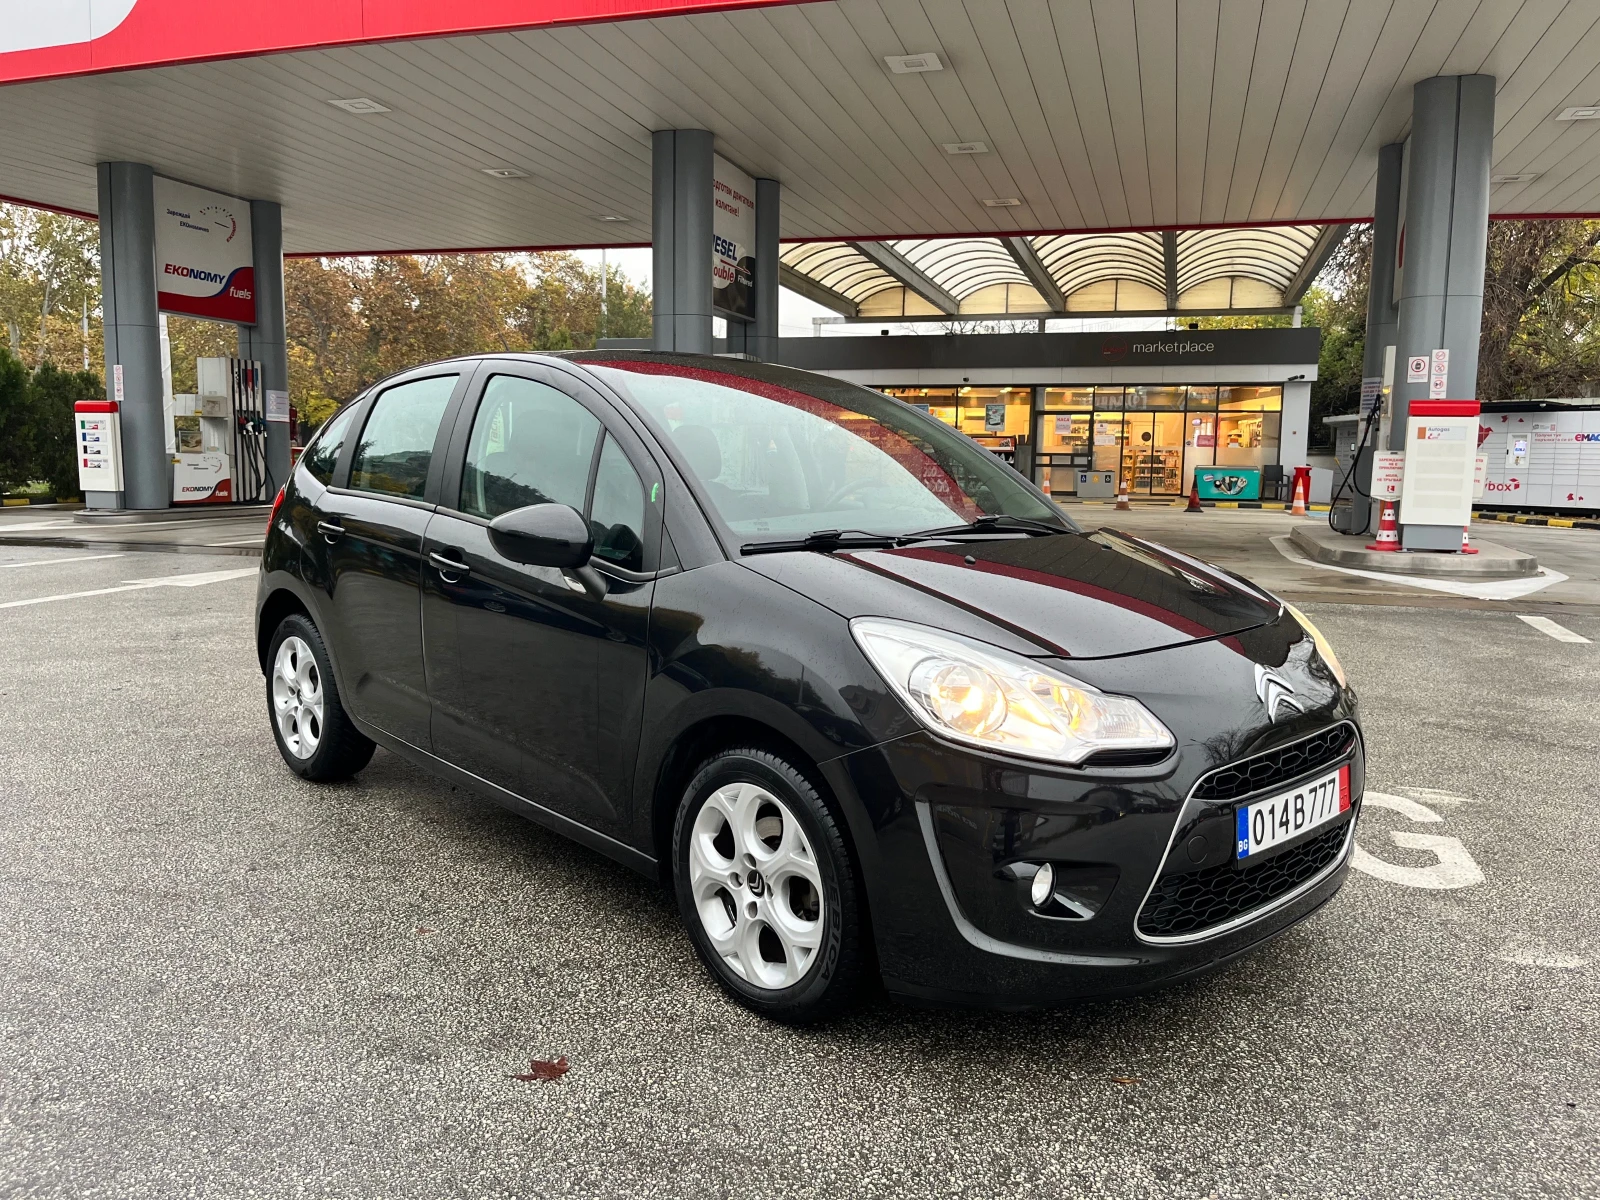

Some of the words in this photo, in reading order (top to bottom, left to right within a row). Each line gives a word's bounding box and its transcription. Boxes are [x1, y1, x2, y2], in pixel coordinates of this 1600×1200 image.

[164, 263, 226, 284] EKONOMY
[229, 286, 252, 300] fuels
[1133, 340, 1215, 355] marketplace
[1575, 433, 1600, 442] eMA
[1253, 777, 1336, 846] 014B777
[1238, 838, 1248, 853] BG
